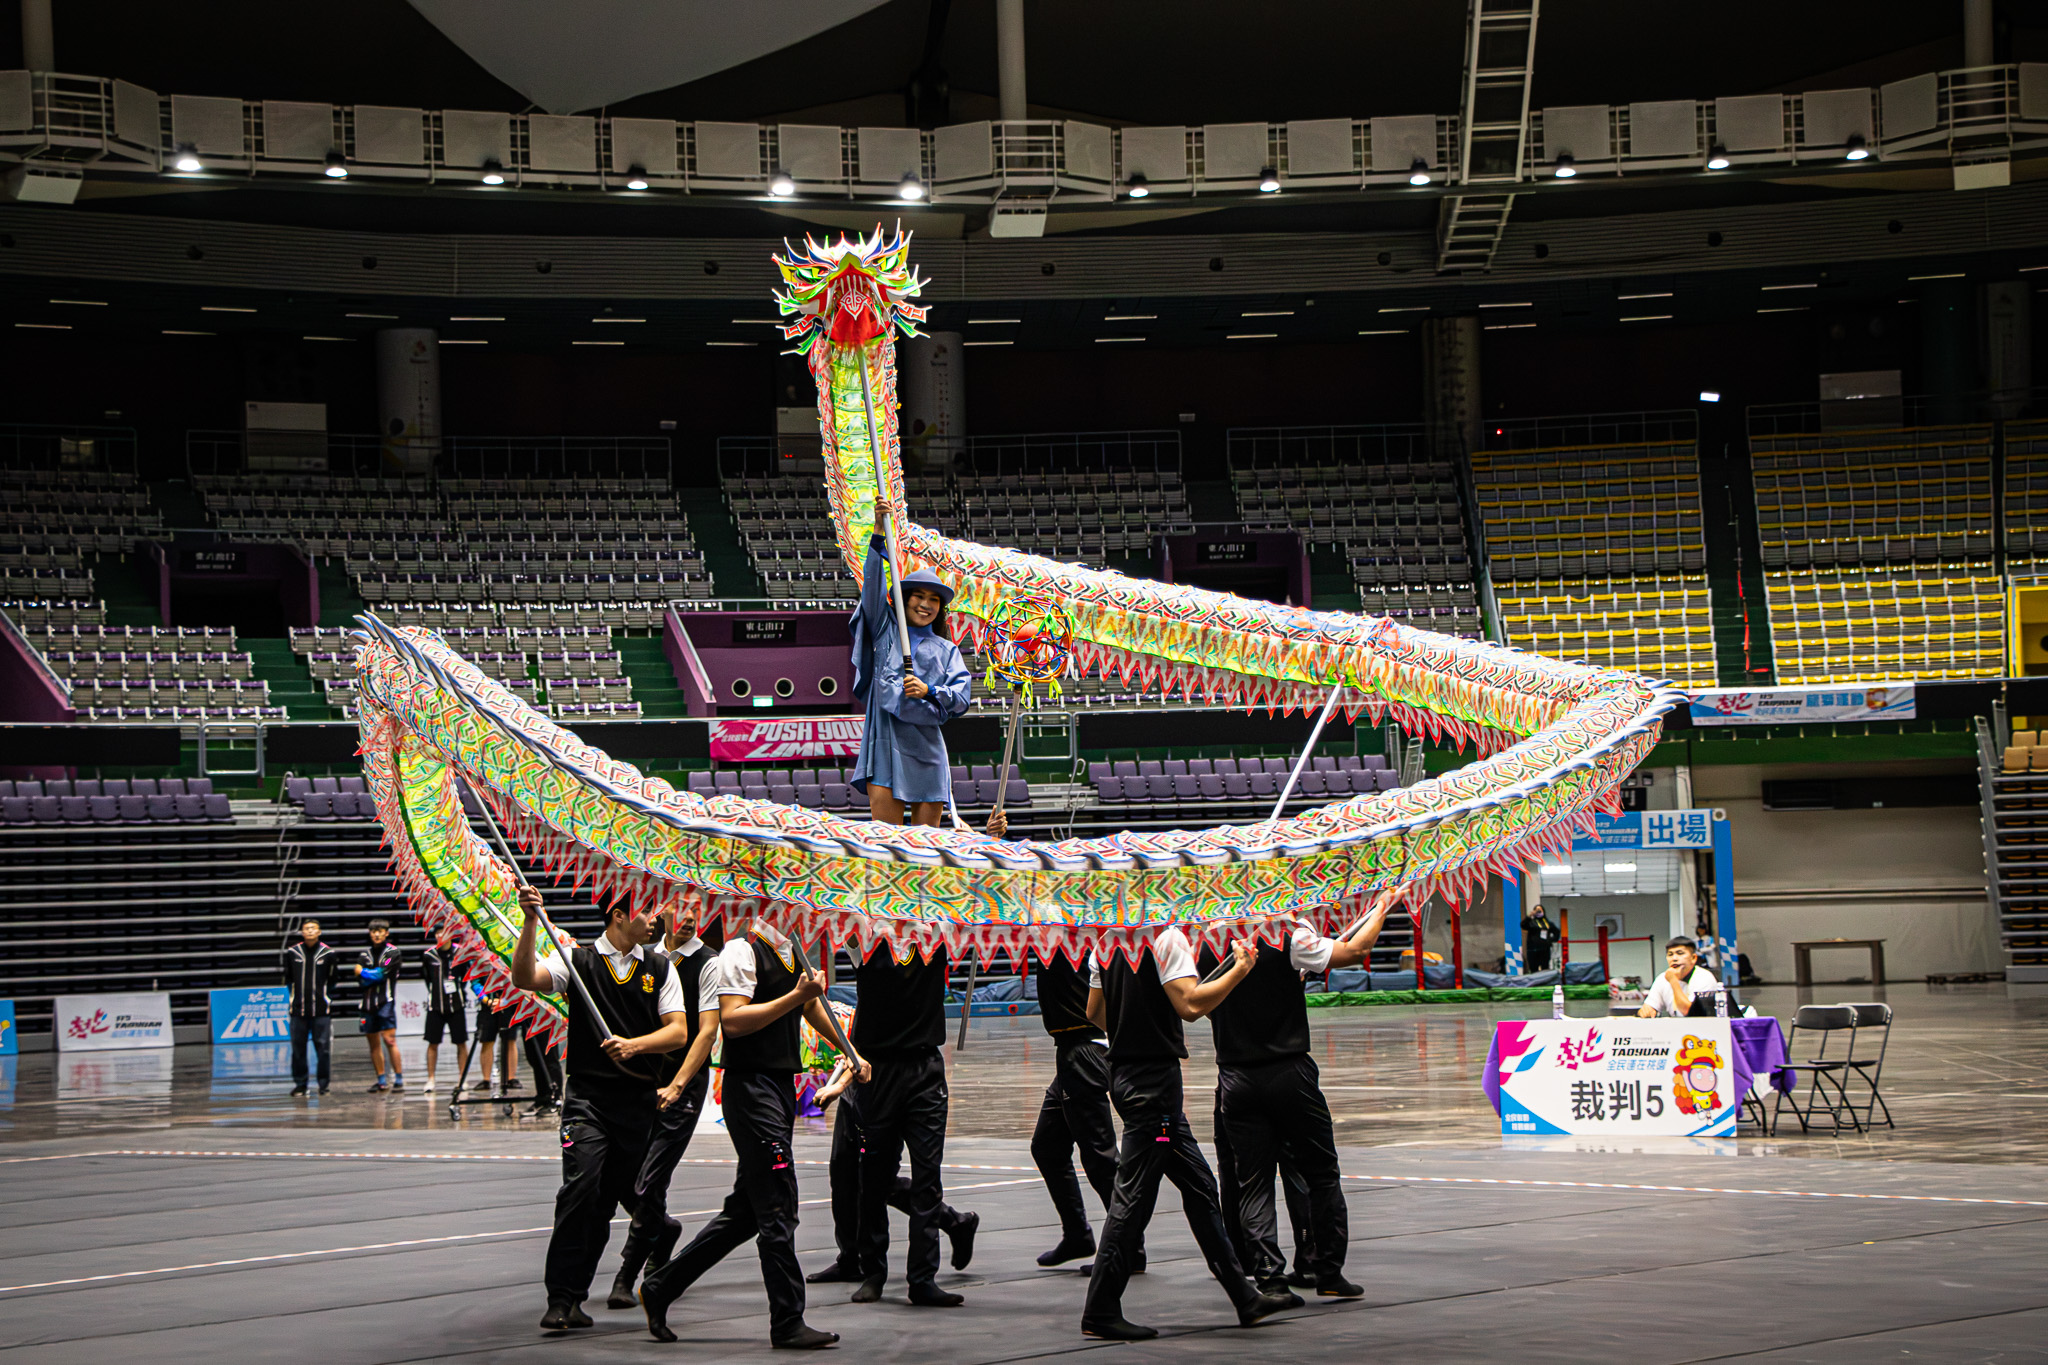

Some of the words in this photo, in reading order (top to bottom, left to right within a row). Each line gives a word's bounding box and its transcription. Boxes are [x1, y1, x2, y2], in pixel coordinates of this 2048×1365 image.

[748, 722, 813, 742] PUSH
[744, 740, 861, 758] LIMITS
[1648, 813, 1707, 844] 出場
[1613, 1037, 1632, 1046] 115
[1611, 1047, 1670, 1057] TAOYUAN
[1570, 1080, 1665, 1120] 裁判5
